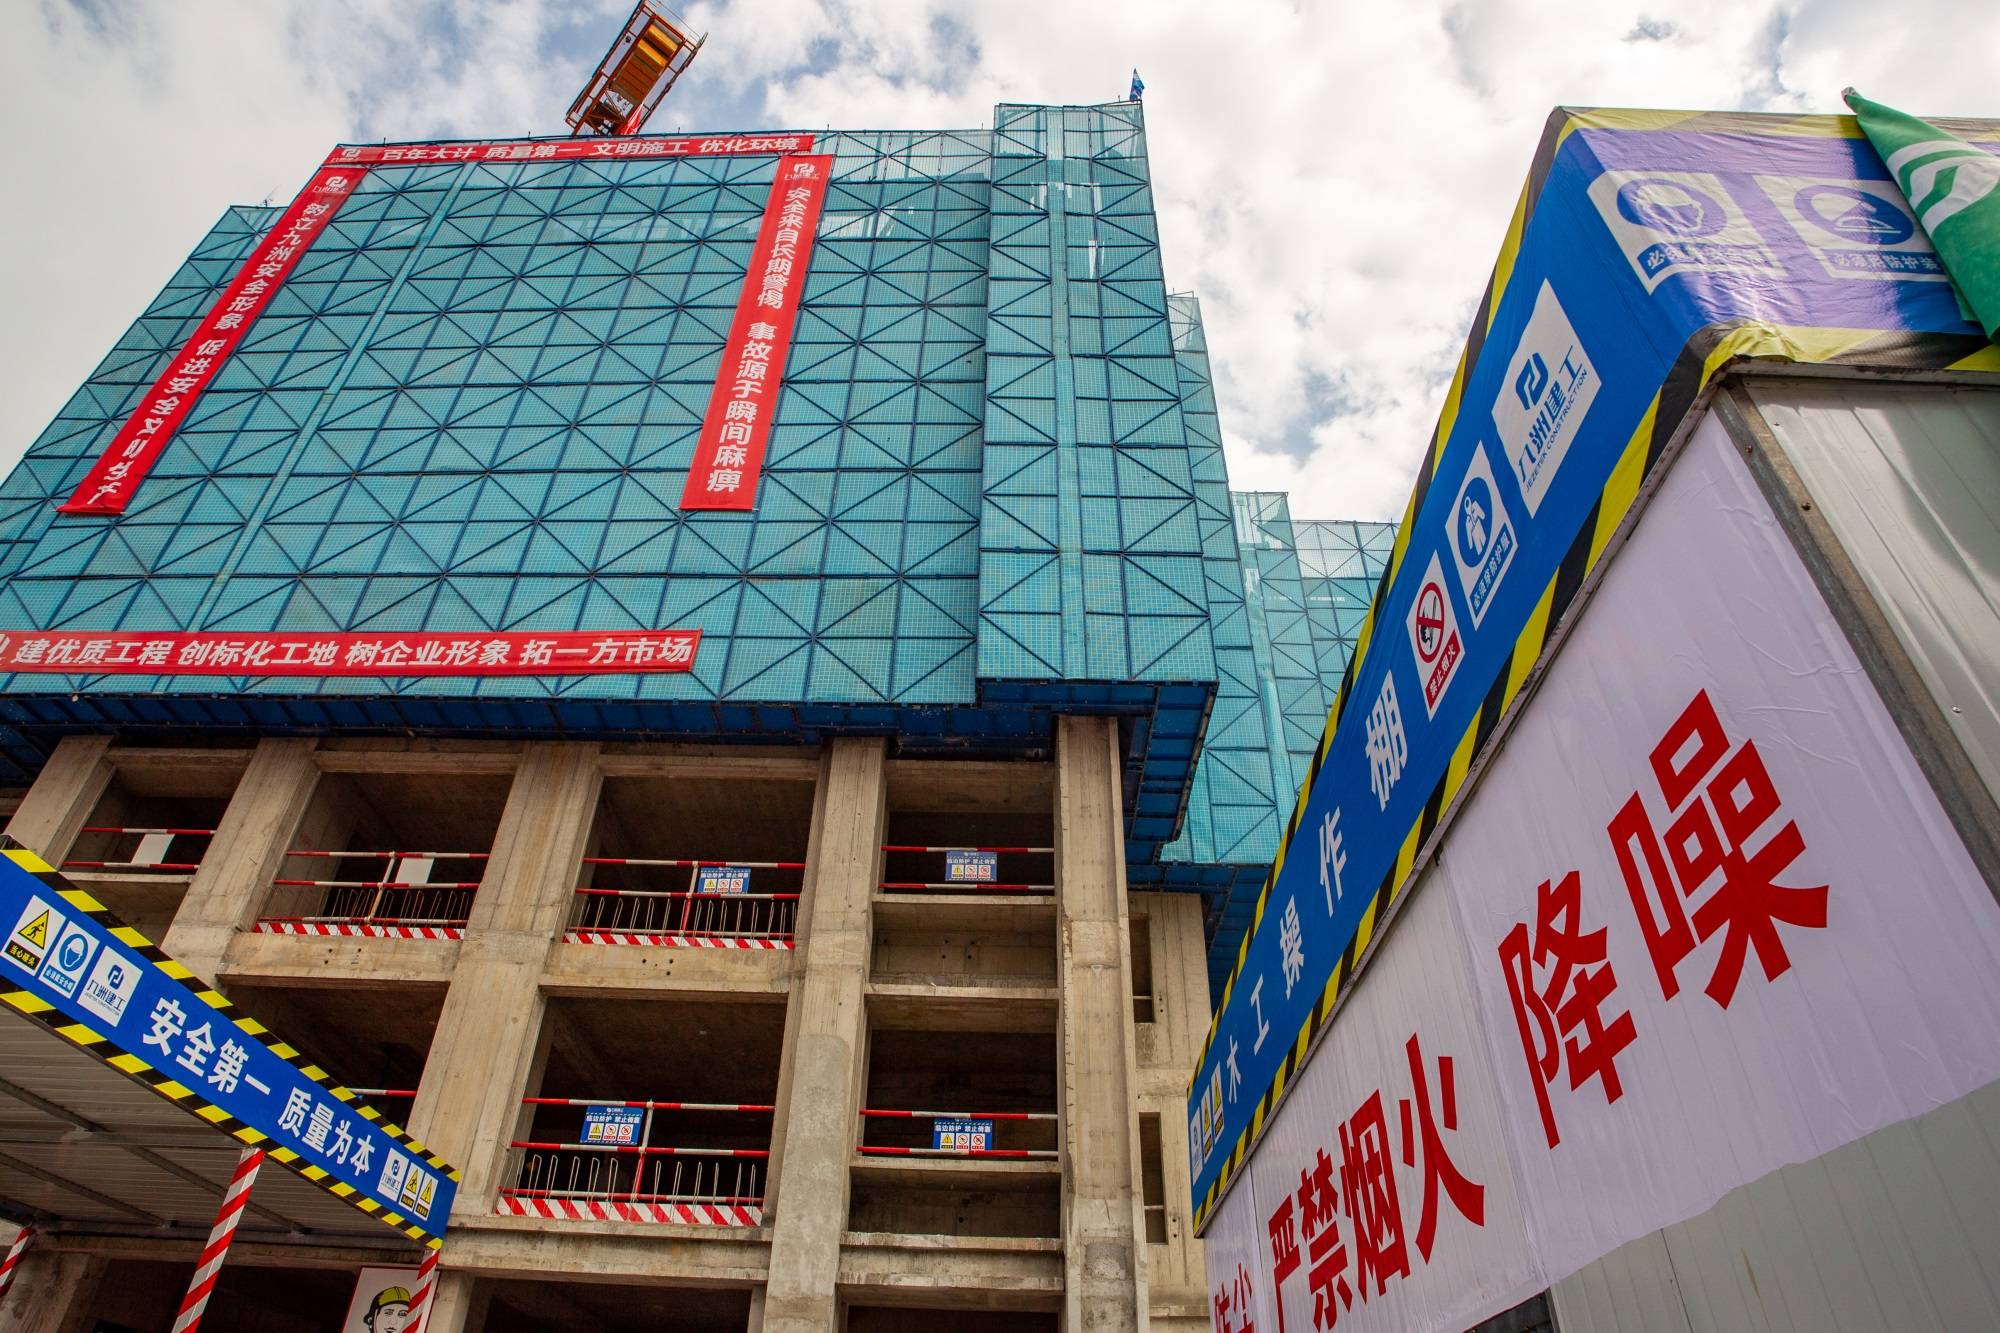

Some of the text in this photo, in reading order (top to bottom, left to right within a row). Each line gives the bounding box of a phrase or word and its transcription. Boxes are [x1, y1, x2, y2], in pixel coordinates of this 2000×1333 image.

[382, 138, 801, 161] 百年大计 质量第一 文明施工 优化环境
[213, 203, 330, 330] 树立九洲安全形象
[757, 187, 811, 309] 安全来自长期警惕
[707, 321, 778, 493] 事故源于瞬间麻痹
[1519, 345, 1583, 483] 九洲建工
[1547, 369, 1587, 451] CONSTRUCTION
[11, 636, 695, 667] 建优质工程 创标化工地 树企业形象 拓一方市场
[1430, 643, 1456, 698] 禁止烟火
[1226, 669, 1408, 1105] 木工操作棚
[1498, 688, 1830, 1150] 降噪
[87, 979, 126, 1012] 九洲建工
[142, 997, 375, 1177] 安全第一 质量为本
[1268, 1033, 1485, 1333] 严禁烟火
